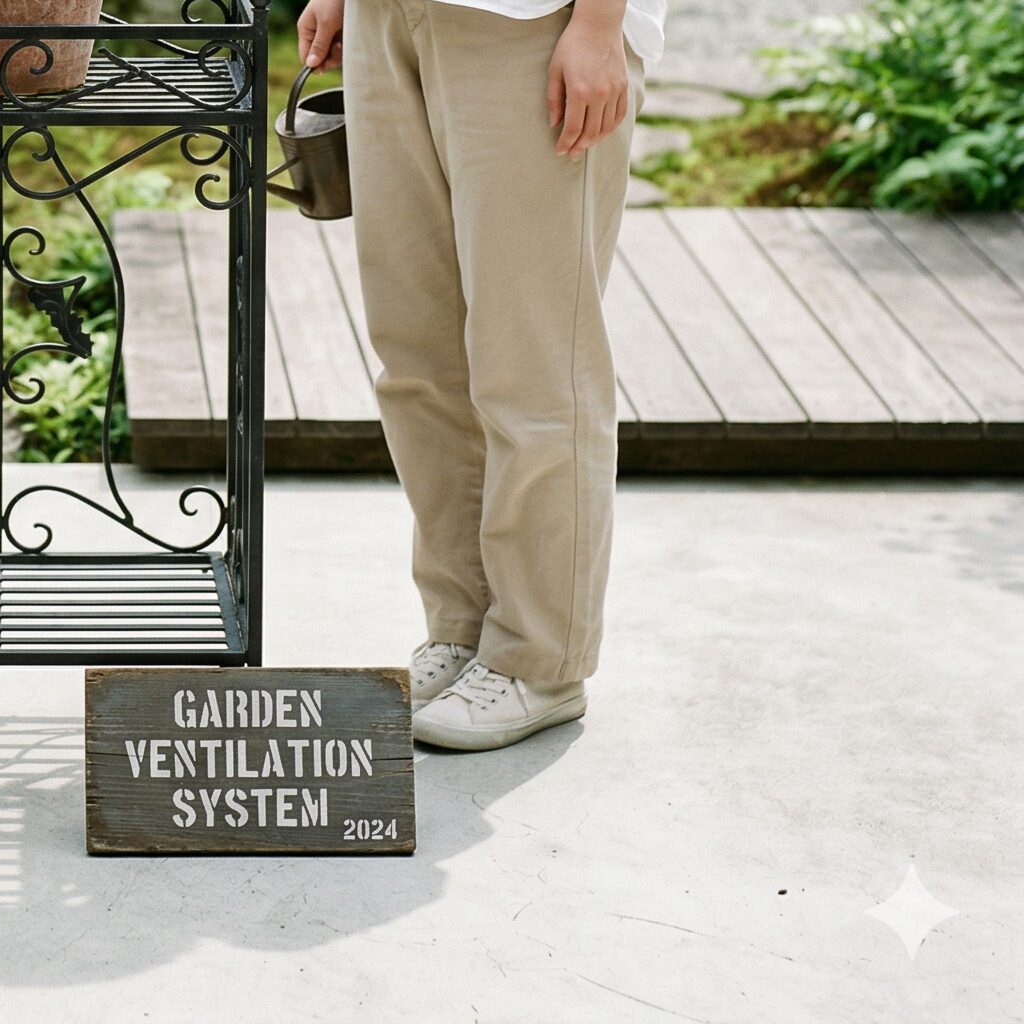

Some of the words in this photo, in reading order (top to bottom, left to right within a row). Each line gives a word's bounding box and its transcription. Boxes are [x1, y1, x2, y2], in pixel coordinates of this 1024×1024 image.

[174, 689, 322, 728] GARDEN
[124, 739, 373, 778] VENTILATION
[172, 788, 328, 827] SYSTEM
[343, 818, 398, 840] 2024
